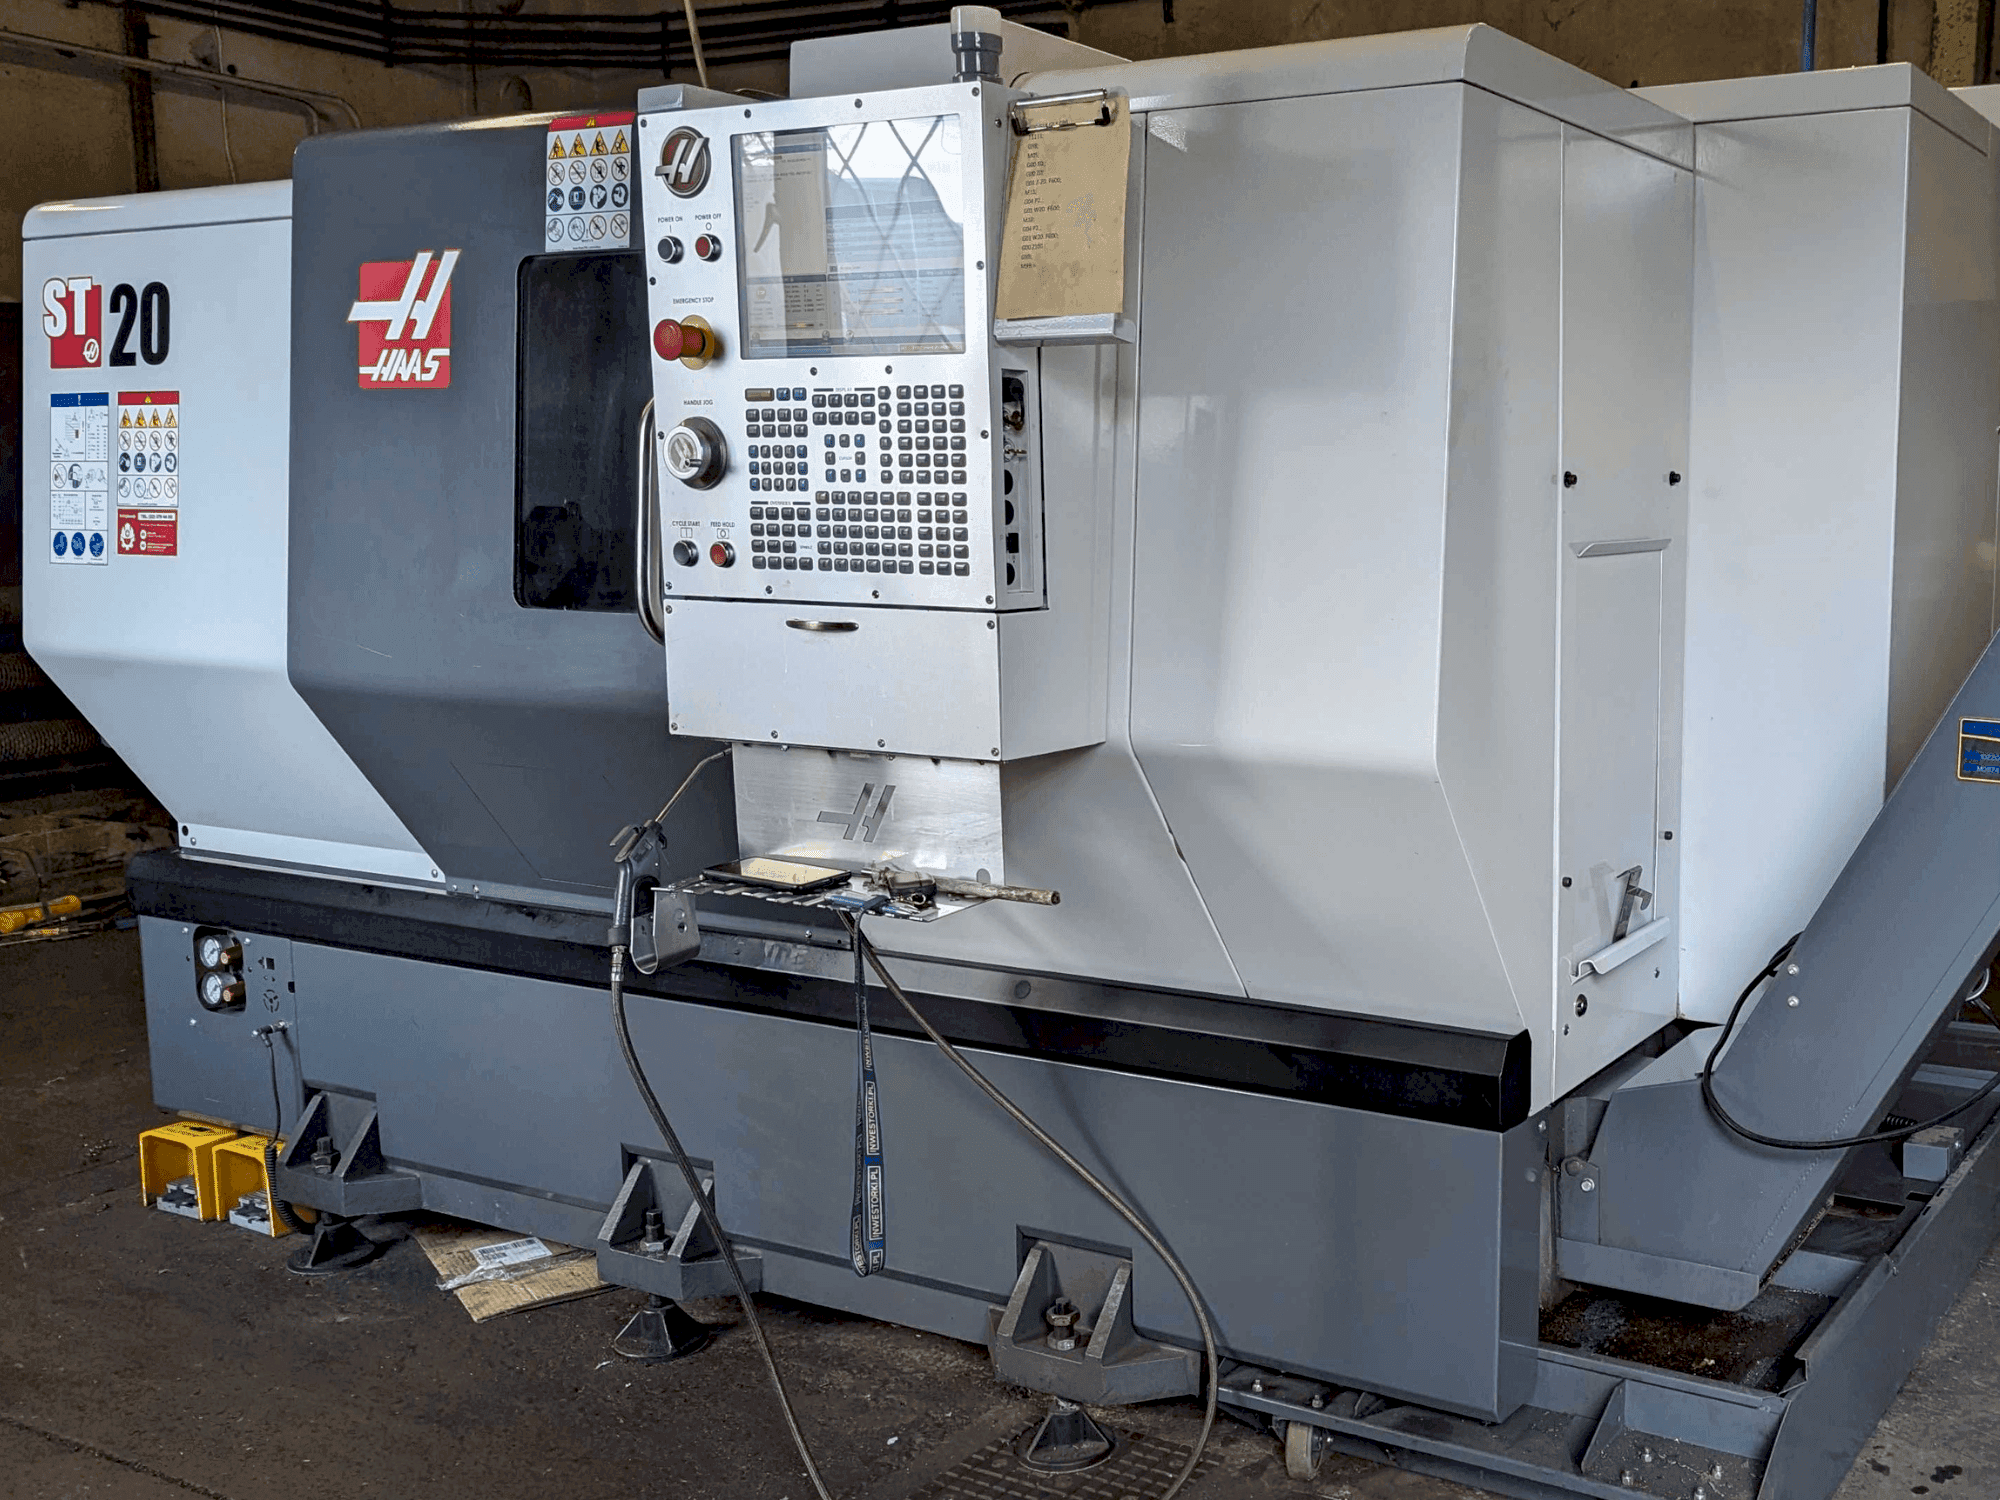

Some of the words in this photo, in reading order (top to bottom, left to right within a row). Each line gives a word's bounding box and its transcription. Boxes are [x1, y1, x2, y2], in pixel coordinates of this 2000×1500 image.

[42, 276, 93, 338] ST
[109, 281, 171, 367] 20
[672, 297, 701, 305] EMERGENCY
[358, 348, 451, 381] HAAS
[868, 1084, 877, 1151] INWESTORKI.PL
[871, 1168, 880, 1238] INWESTORKI.PL
